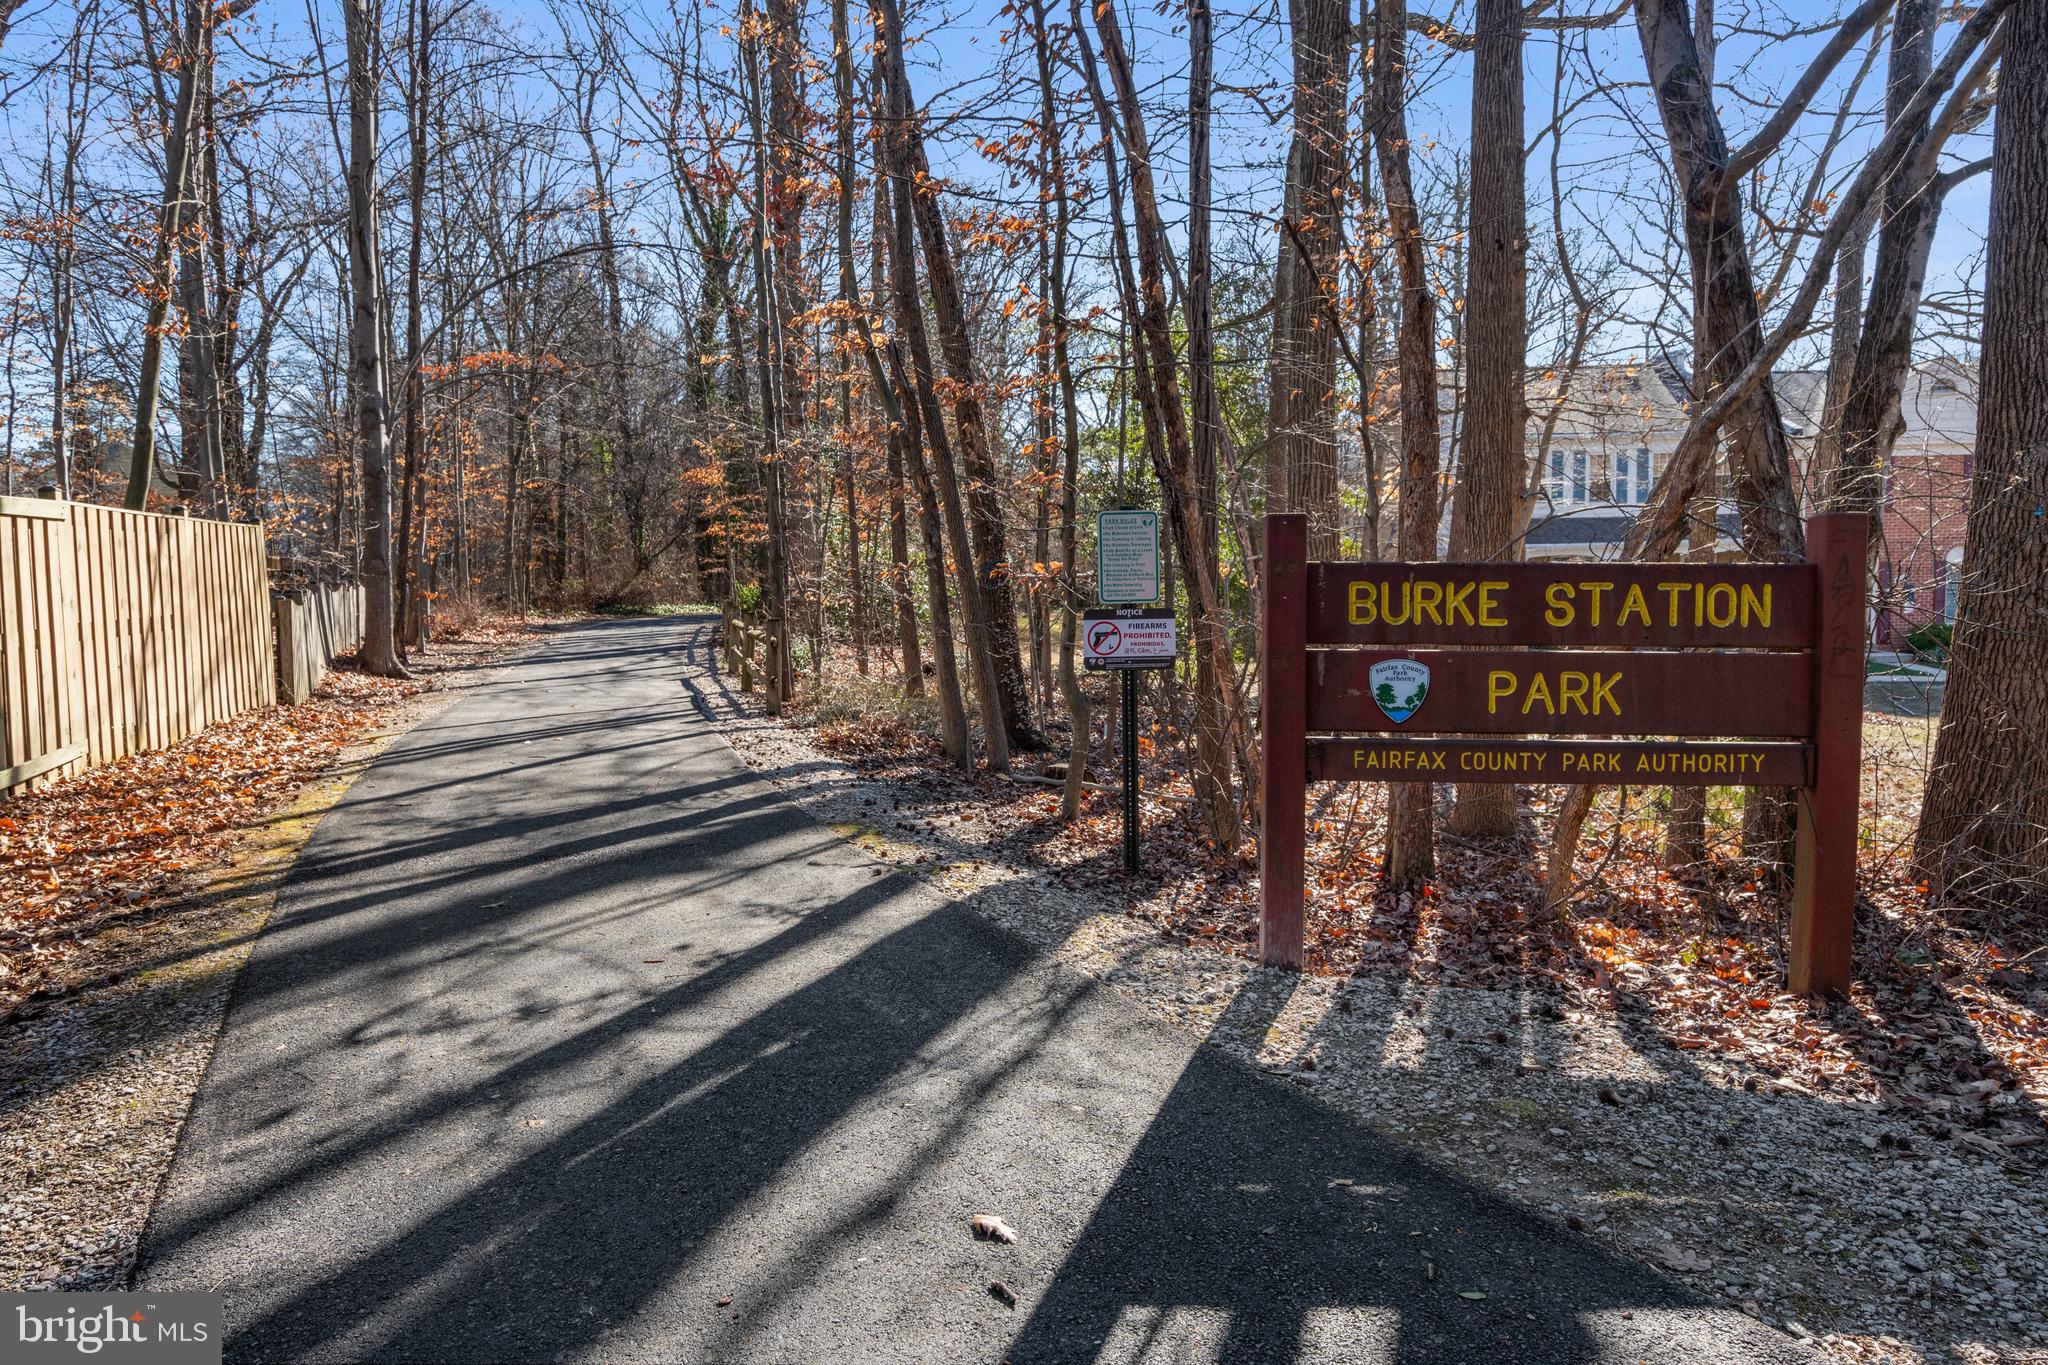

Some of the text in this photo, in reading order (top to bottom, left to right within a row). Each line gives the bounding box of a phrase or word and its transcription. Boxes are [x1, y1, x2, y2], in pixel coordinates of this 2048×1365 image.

[1347, 581, 1773, 628] BURKE STATION
[1376, 664, 1426, 675] Fairfax County
[1488, 670, 1622, 716] PARK
[1353, 750, 1766, 773] FAIRFAX COUNTY PARK AUTHORITY
